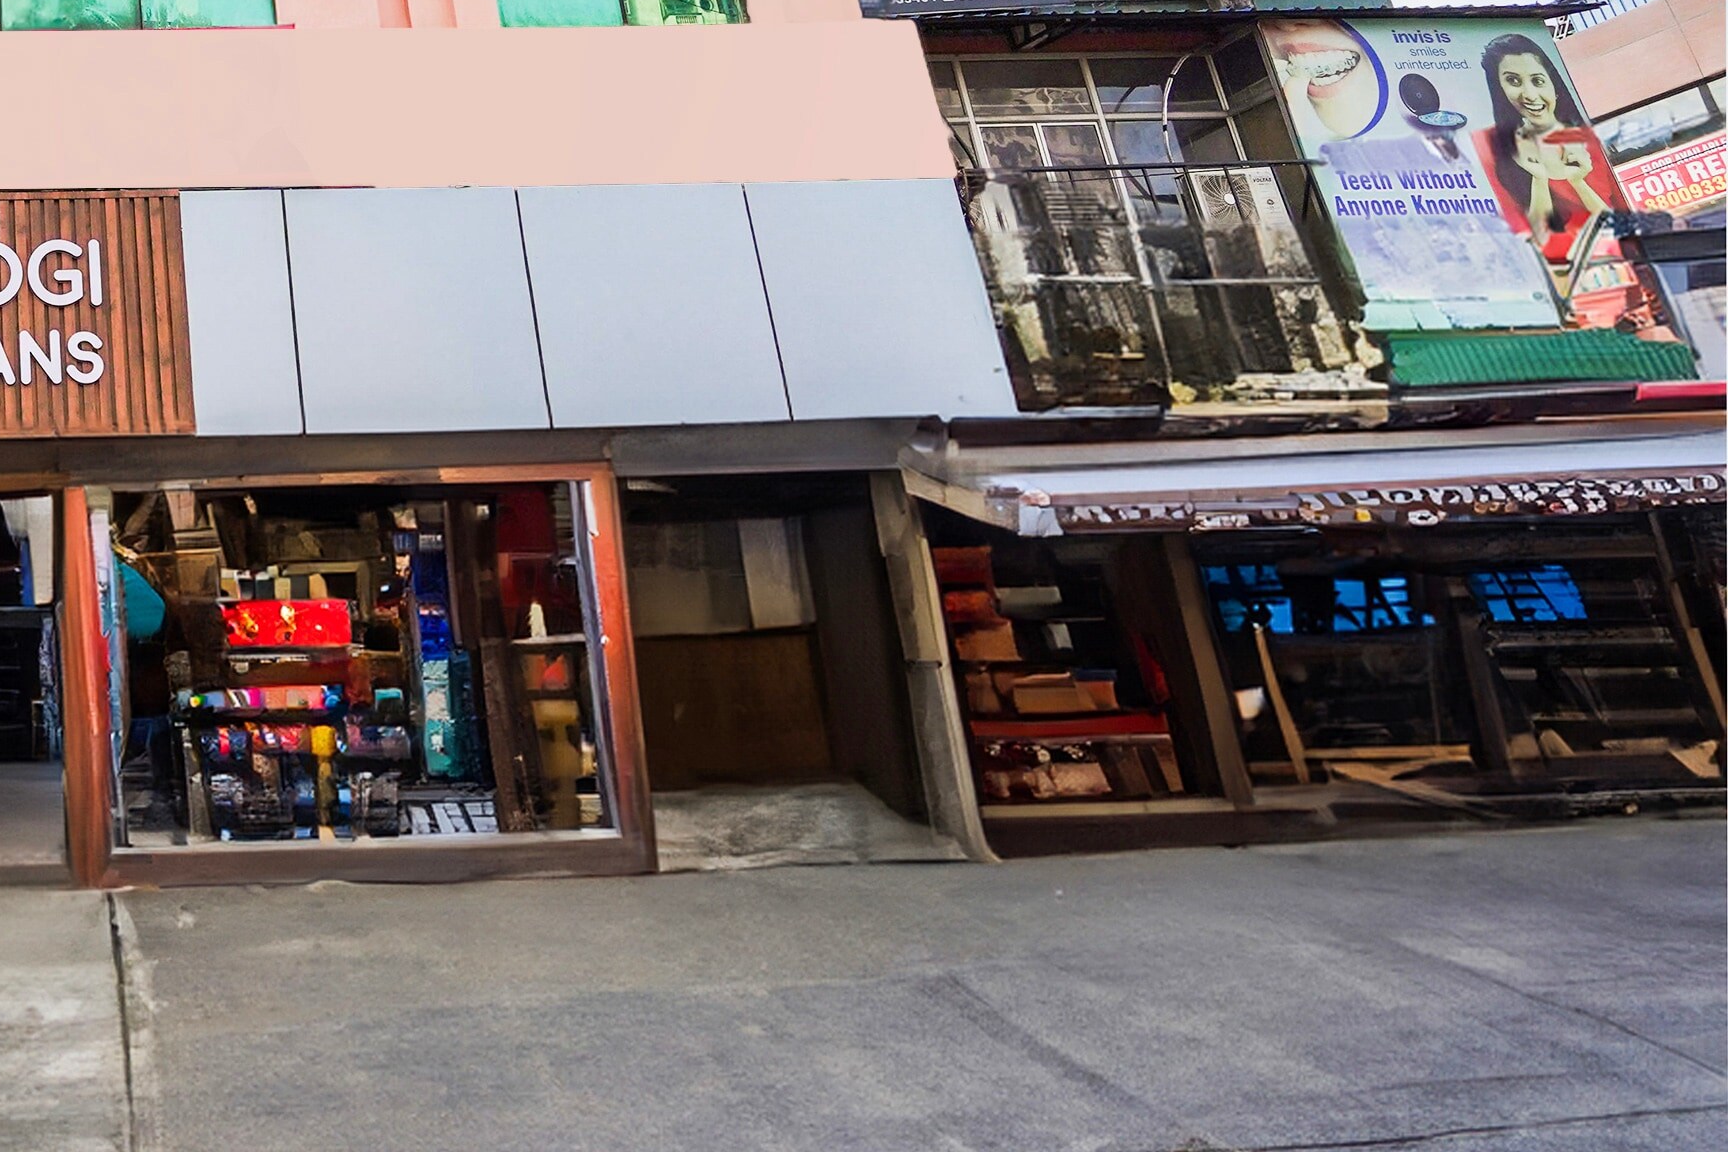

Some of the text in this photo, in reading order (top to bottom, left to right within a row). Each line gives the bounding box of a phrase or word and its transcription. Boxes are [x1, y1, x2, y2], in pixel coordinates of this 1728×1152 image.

[1410, 47, 1447, 57] smiles
[1335, 169, 1477, 190] Teeth Without
[1628, 169, 1685, 202] FOR
[1644, 175, 1726, 210] 8800933
[1334, 194, 1500, 220] Anyone Knowing
